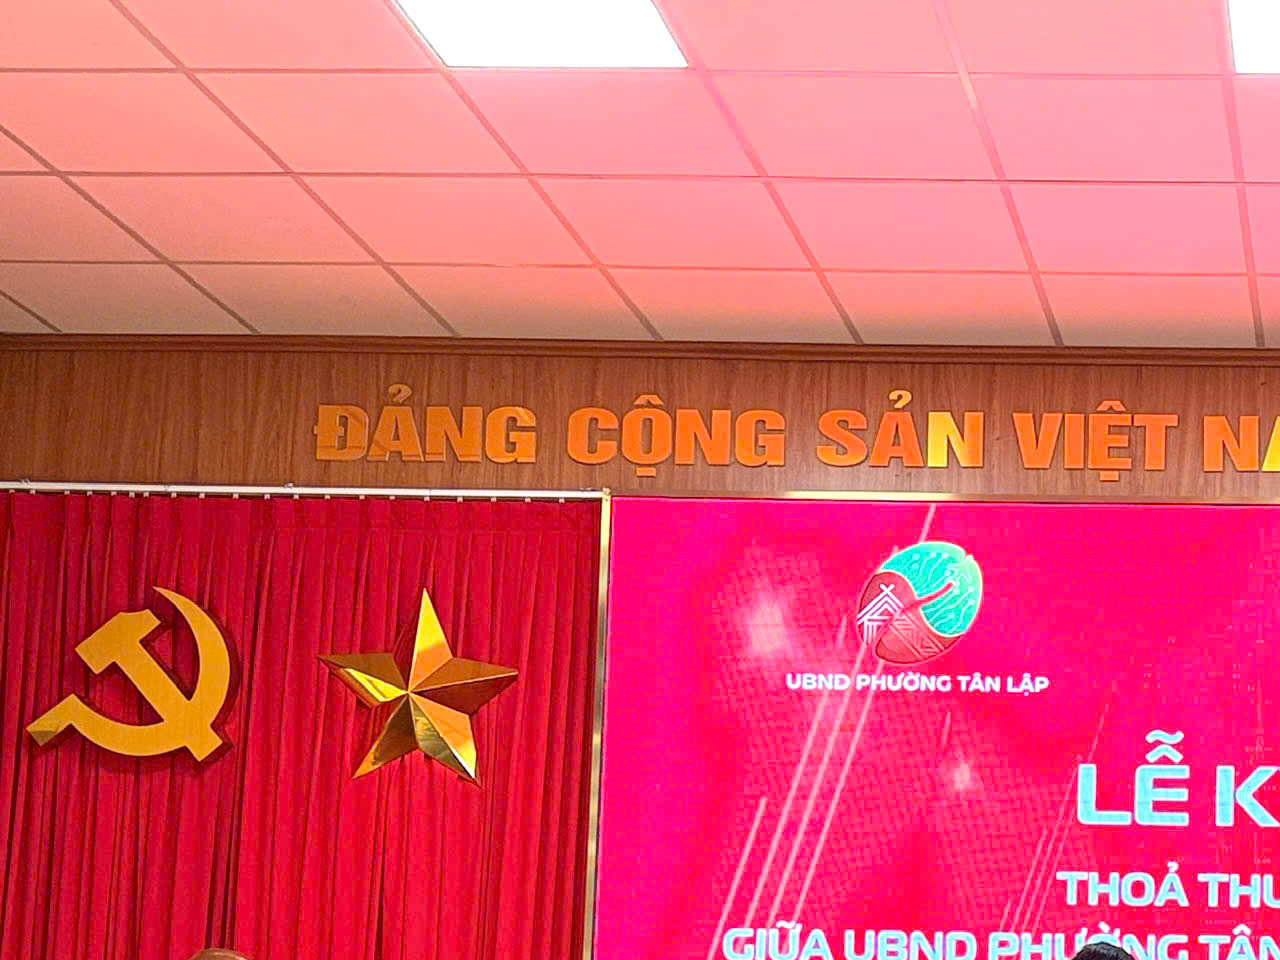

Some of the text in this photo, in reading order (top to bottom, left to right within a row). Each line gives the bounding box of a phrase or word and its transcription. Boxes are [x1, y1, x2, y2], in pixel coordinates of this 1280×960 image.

[313, 384, 537, 464] ĐẢNG
[567, 394, 786, 478] CỘNG
[816, 390, 985, 468] SẢN
[1012, 400, 1179, 482] VIỆT
[785, 671, 1050, 697] UBND PHƯỜNG TÂN LẬP
[1077, 729, 1190, 827] LỄ
[1056, 861, 1189, 907] THOẢ
